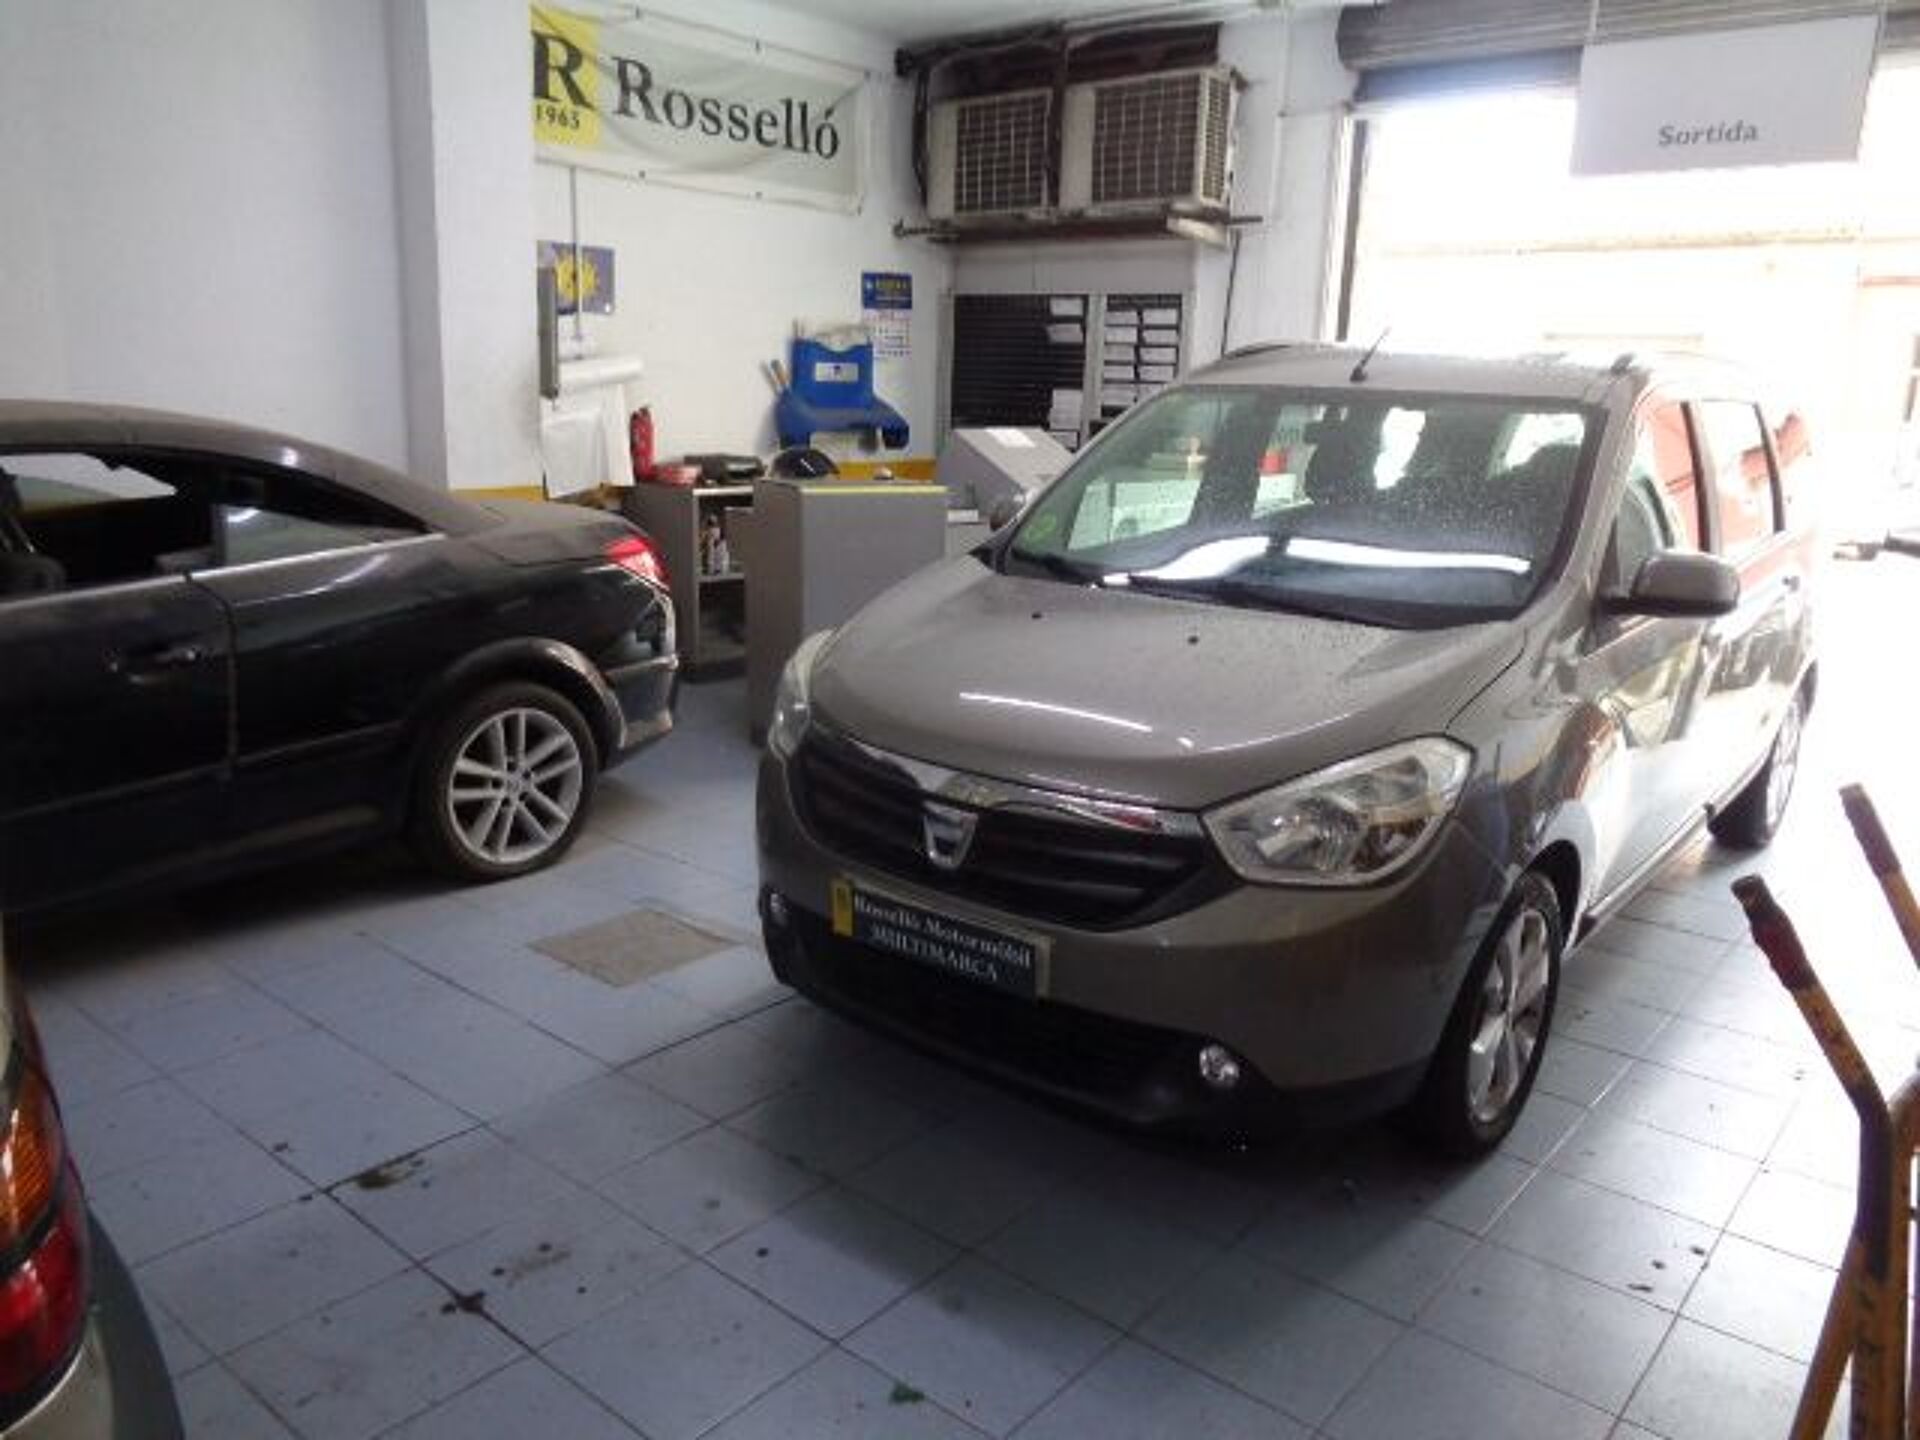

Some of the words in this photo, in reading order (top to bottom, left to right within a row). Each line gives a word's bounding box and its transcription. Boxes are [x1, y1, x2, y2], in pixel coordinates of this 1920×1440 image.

[531, 29, 596, 112] R
[612, 56, 840, 160] Rosselló
[1658, 119, 1759, 146] Sortida
